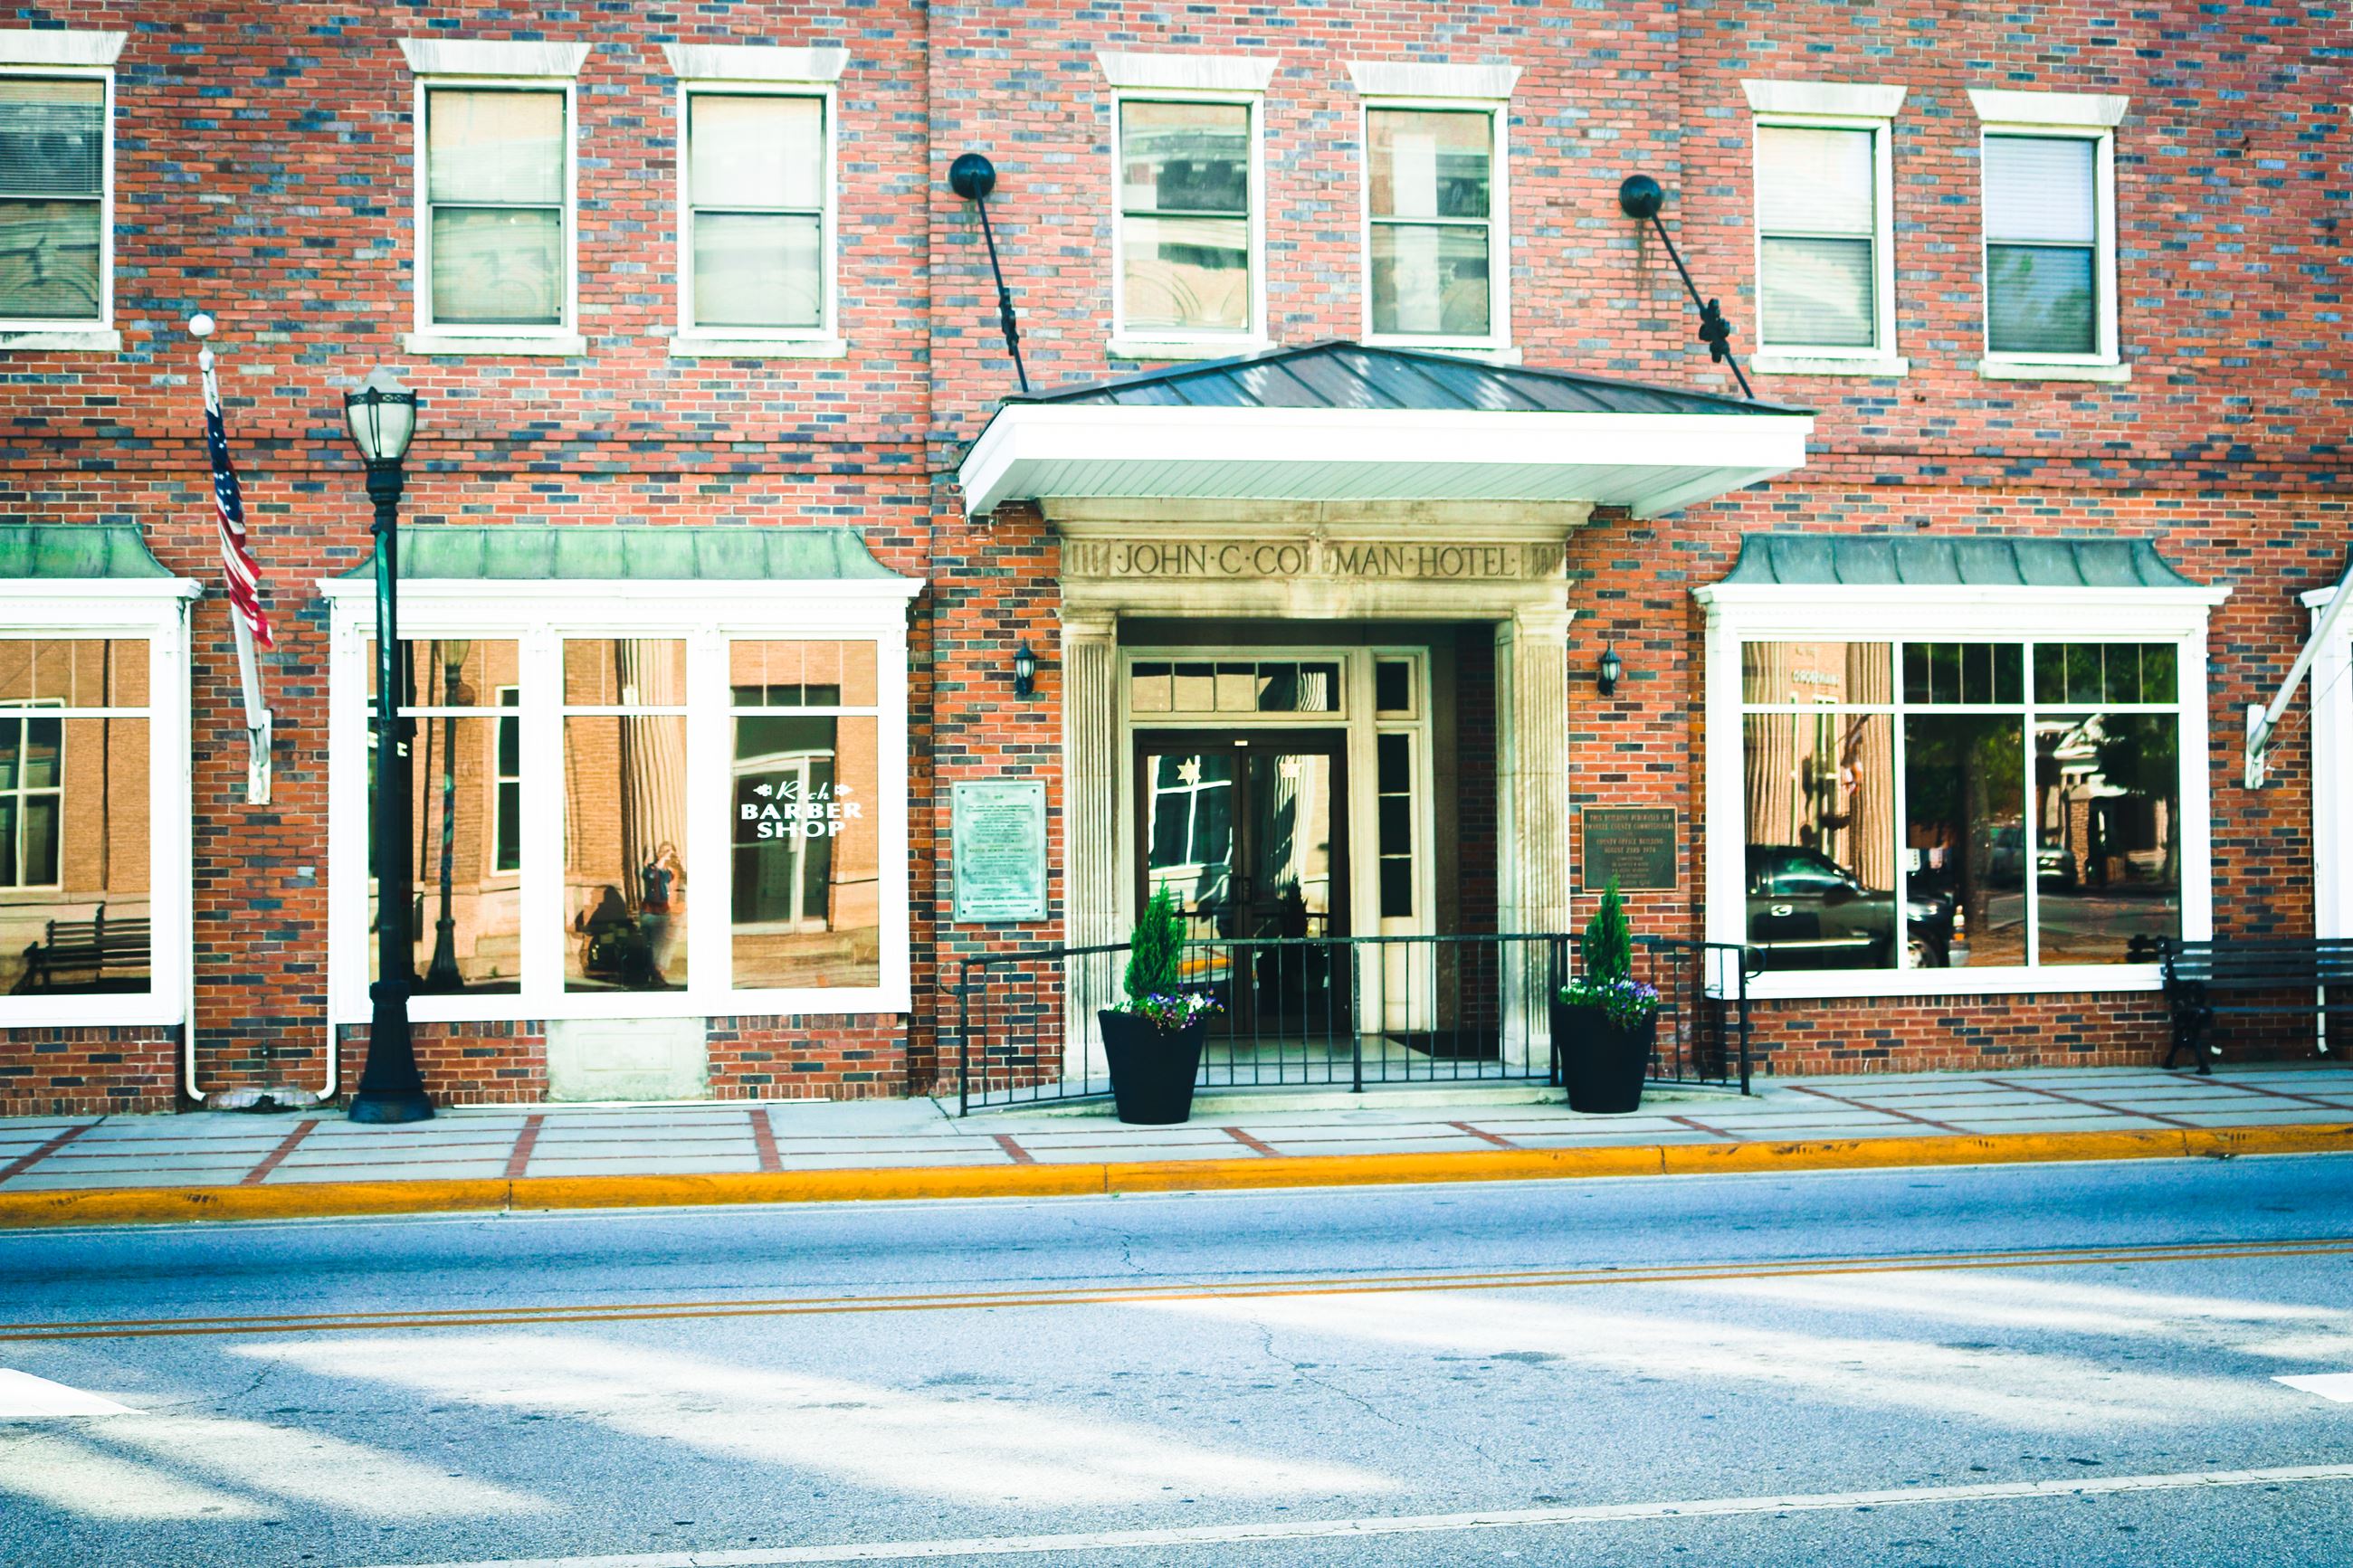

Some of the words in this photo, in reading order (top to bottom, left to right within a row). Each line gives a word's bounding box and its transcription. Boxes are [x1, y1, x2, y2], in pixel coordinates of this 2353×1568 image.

[1117, 545, 1206, 574] JOHN
[1219, 545, 1242, 574] C
[1418, 546, 1516, 576] HOTEL
[776, 781, 830, 800] Rich
[741, 803, 863, 820] BARBER
[757, 821, 846, 838] SHOP
